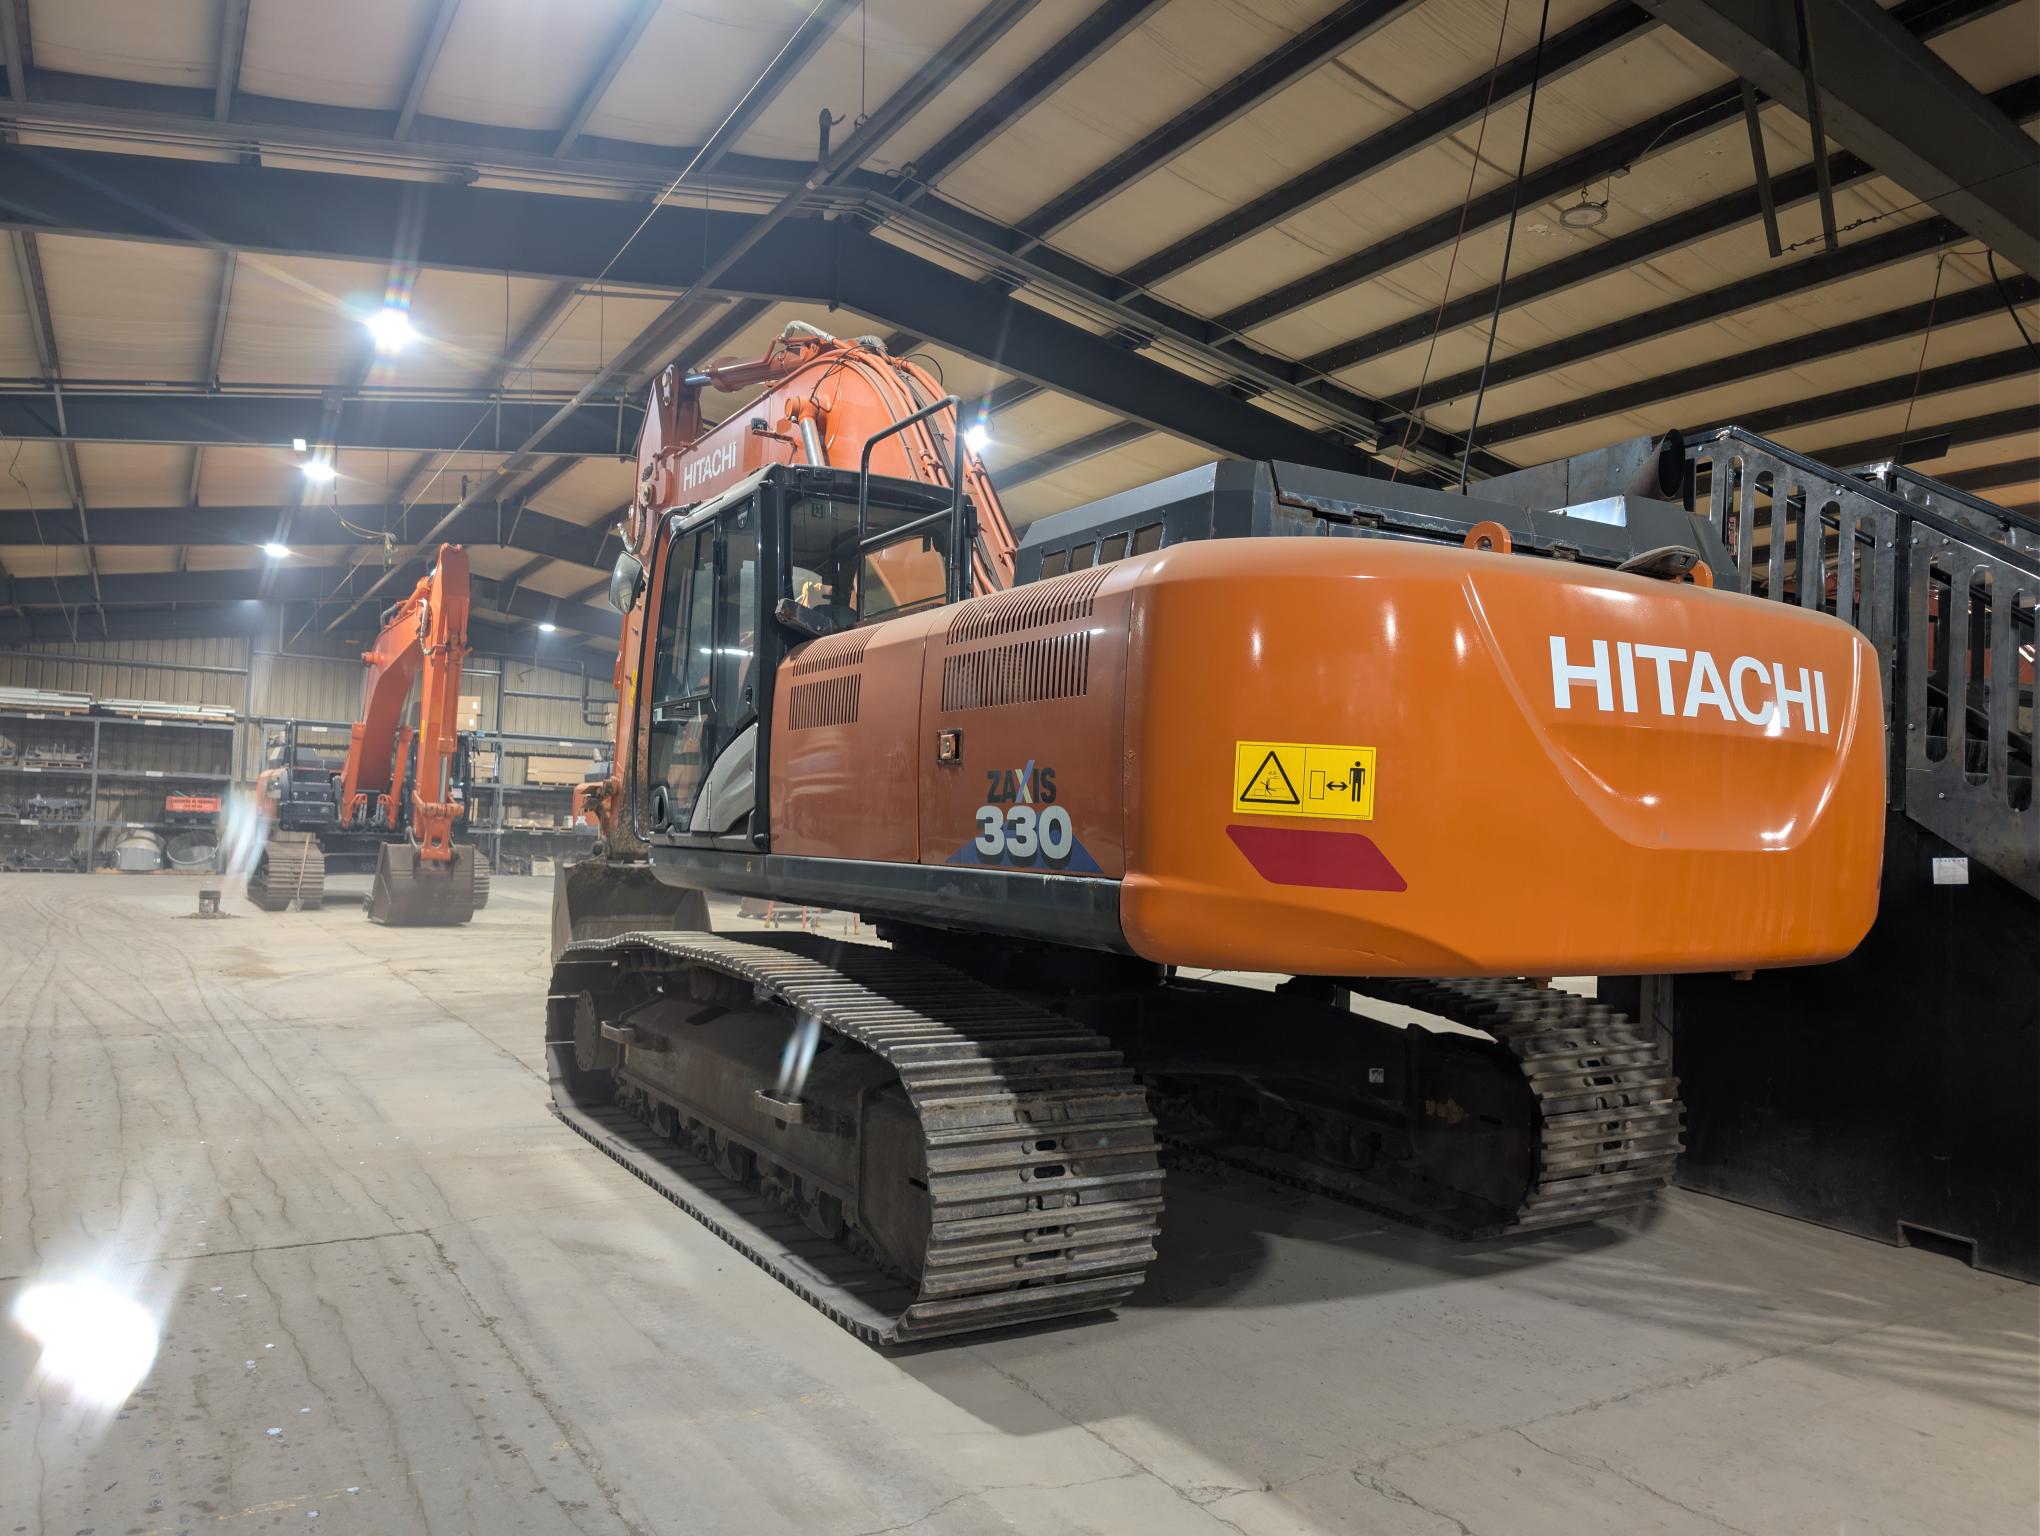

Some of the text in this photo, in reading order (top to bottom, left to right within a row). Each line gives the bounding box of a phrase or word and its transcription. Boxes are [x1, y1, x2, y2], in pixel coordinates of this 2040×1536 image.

[683, 441, 737, 492] HITACHI
[1549, 635, 1830, 735] HITACHI
[987, 759, 1057, 804] ZAXIS
[975, 805, 1073, 861] 330
